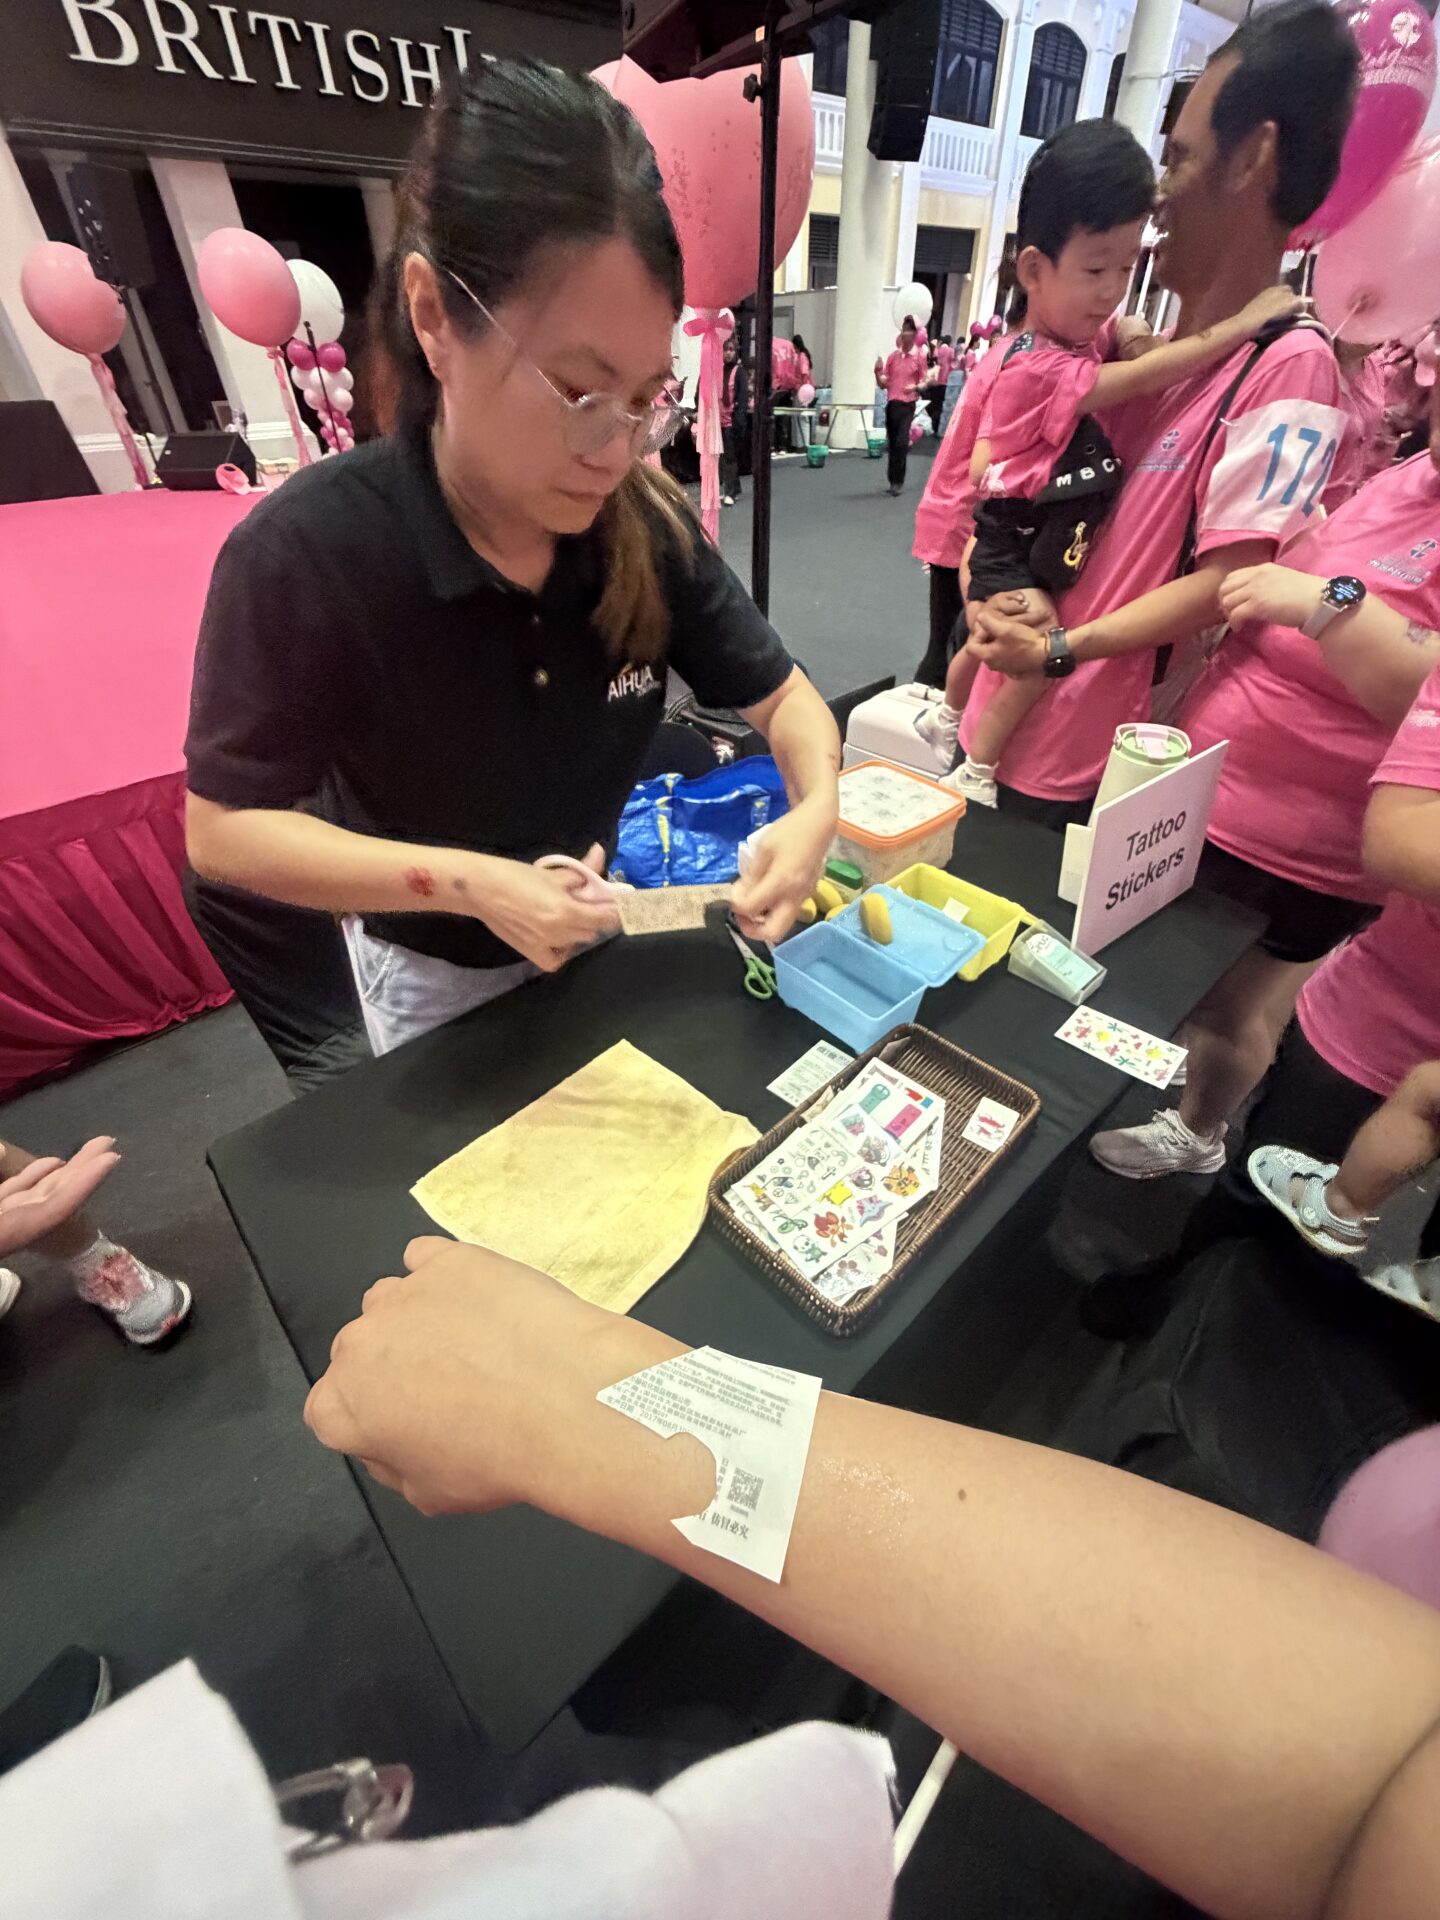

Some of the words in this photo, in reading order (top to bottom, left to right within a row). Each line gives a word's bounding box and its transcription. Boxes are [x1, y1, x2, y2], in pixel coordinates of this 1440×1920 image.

[62, 0, 441, 108] BRITISH
[1126, 810, 1187, 862] Tattoo
[1105, 847, 1185, 910] Stickers
